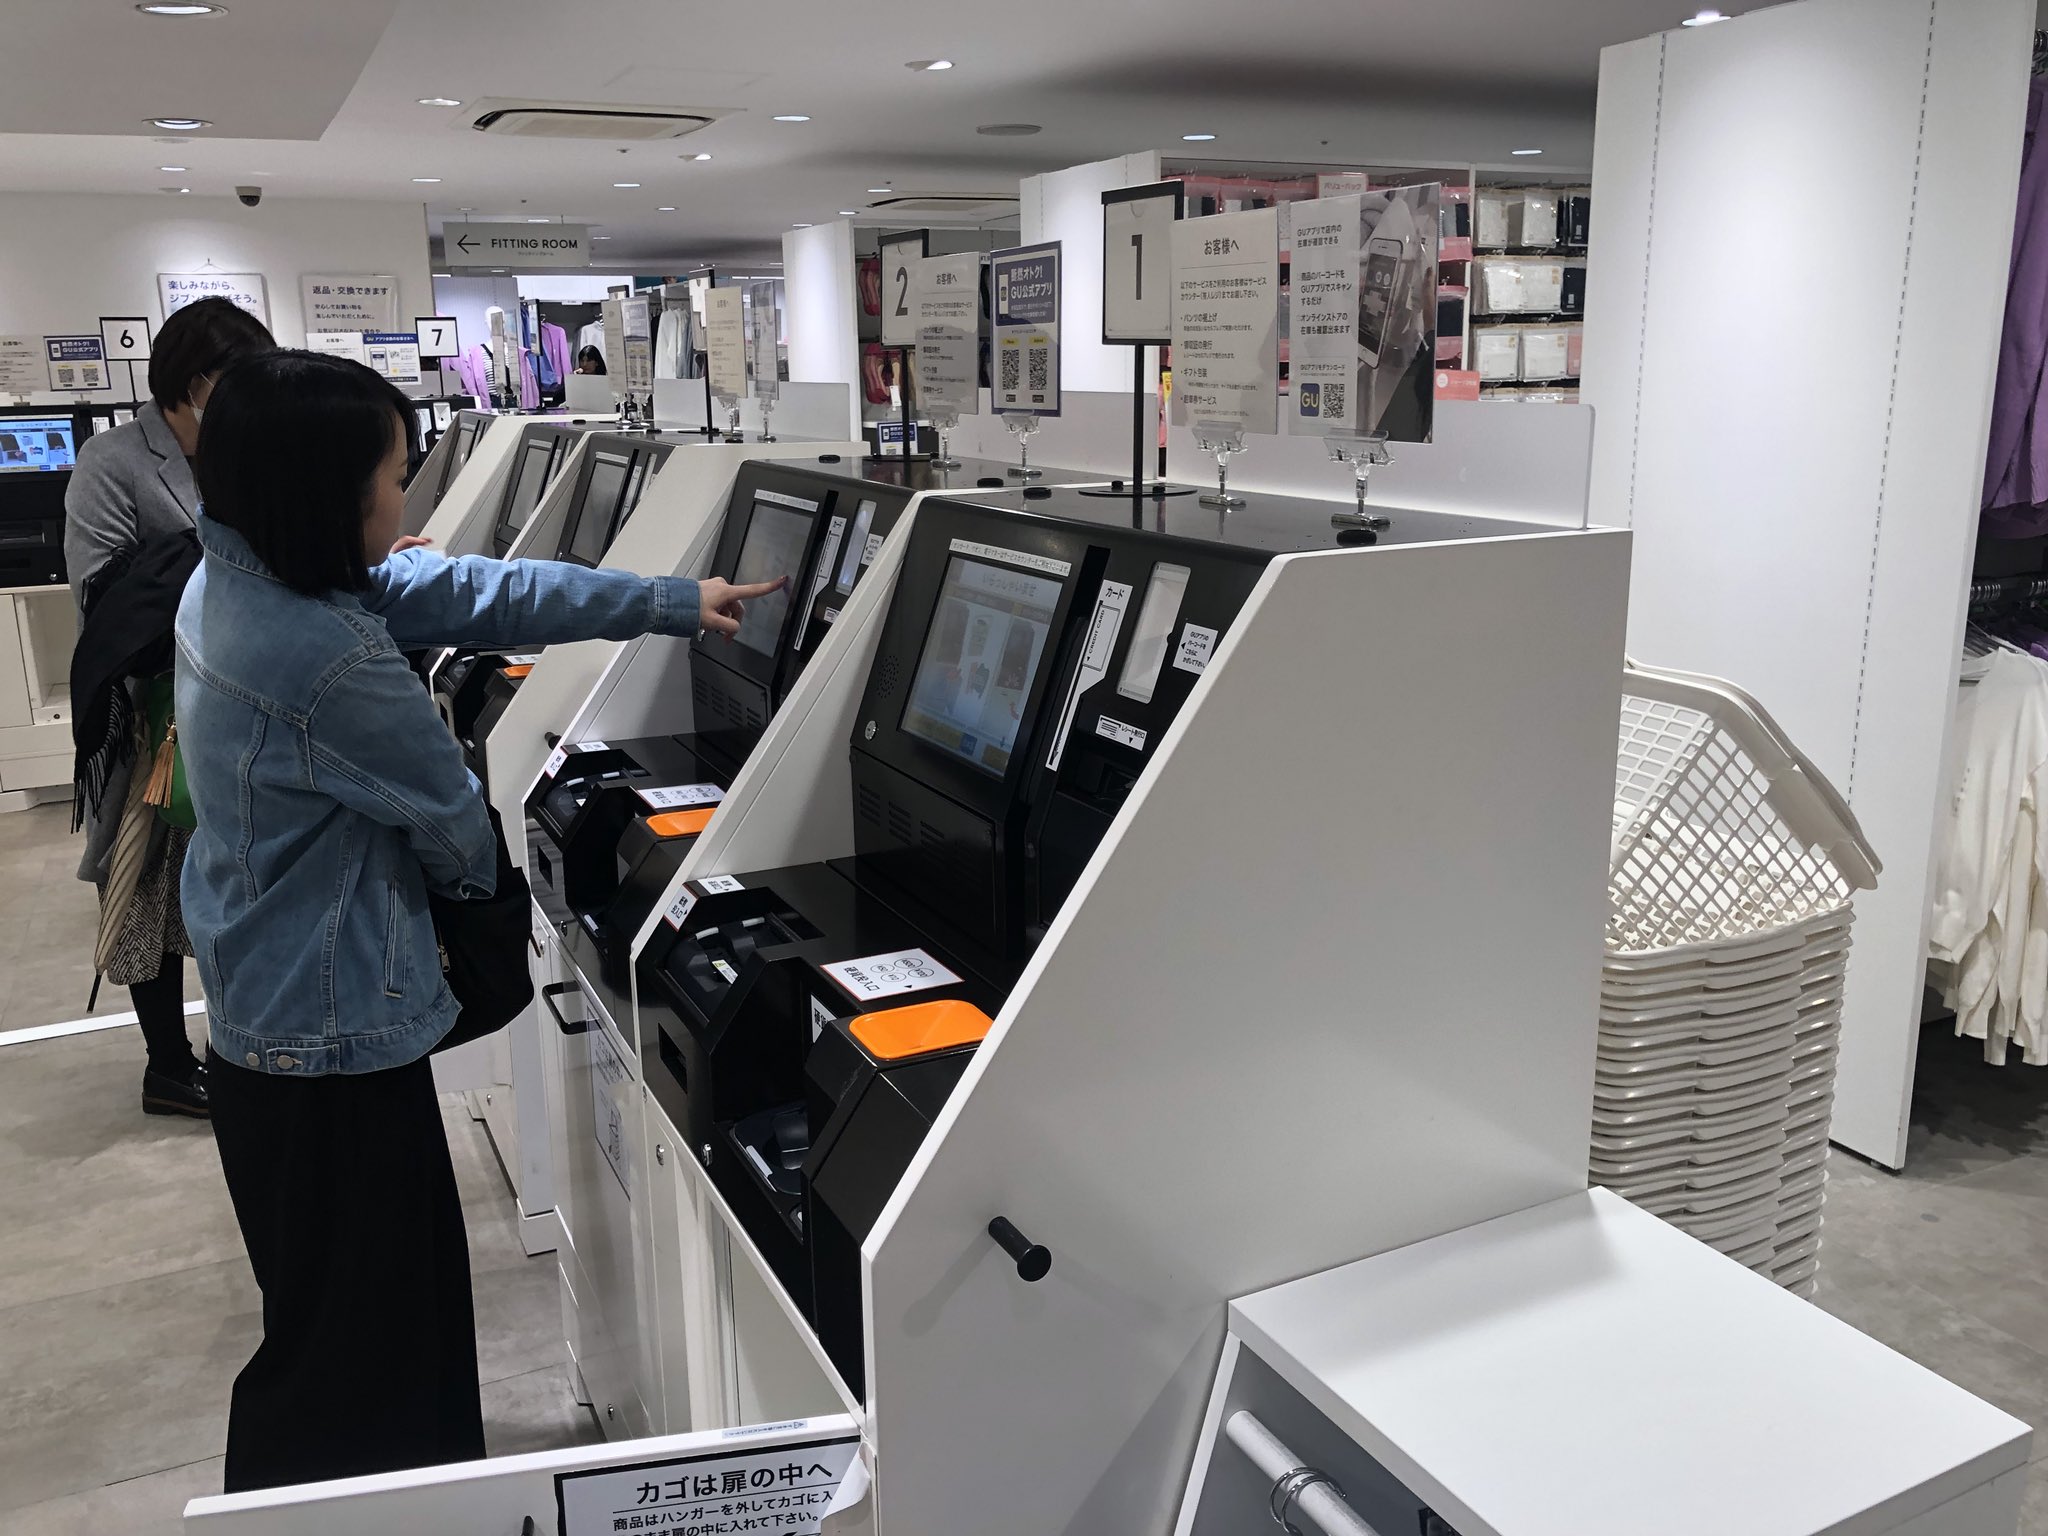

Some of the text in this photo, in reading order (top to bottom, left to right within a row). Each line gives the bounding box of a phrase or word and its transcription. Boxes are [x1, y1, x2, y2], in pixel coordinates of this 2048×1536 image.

[1297, 225, 1342, 237] GUアプリで店内の
[491, 238, 578, 249] FITTING ROOM
[1204, 238, 1240, 255] お客様へ
[1297, 236, 1339, 248] 在庫が確認できる
[1131, 234, 1142, 300] 1
[1301, 270, 1345, 281] 商品のバーコードを
[168, 281, 236, 290] 楽しみながら、
[312, 286, 389, 295] 返品・交換できます
[895, 266, 908, 316] 2
[1010, 282, 1053, 300] GU公式アプリ
[1301, 283, 1352, 294] GUアプリでスキャン
[1301, 297, 1322, 306] するだけ
[1300, 312, 1347, 322] オンラインストアの
[120, 329, 135, 348] 6
[431, 328, 443, 347] 7
[1301, 392, 1319, 408] GU
[1105, 586, 1125, 600] カード
[1088, 609, 1105, 654] CREDIT CARD
[843, 966, 881, 992] 硬貨投入口
[637, 1463, 833, 1505] カゴは扉の中へ
